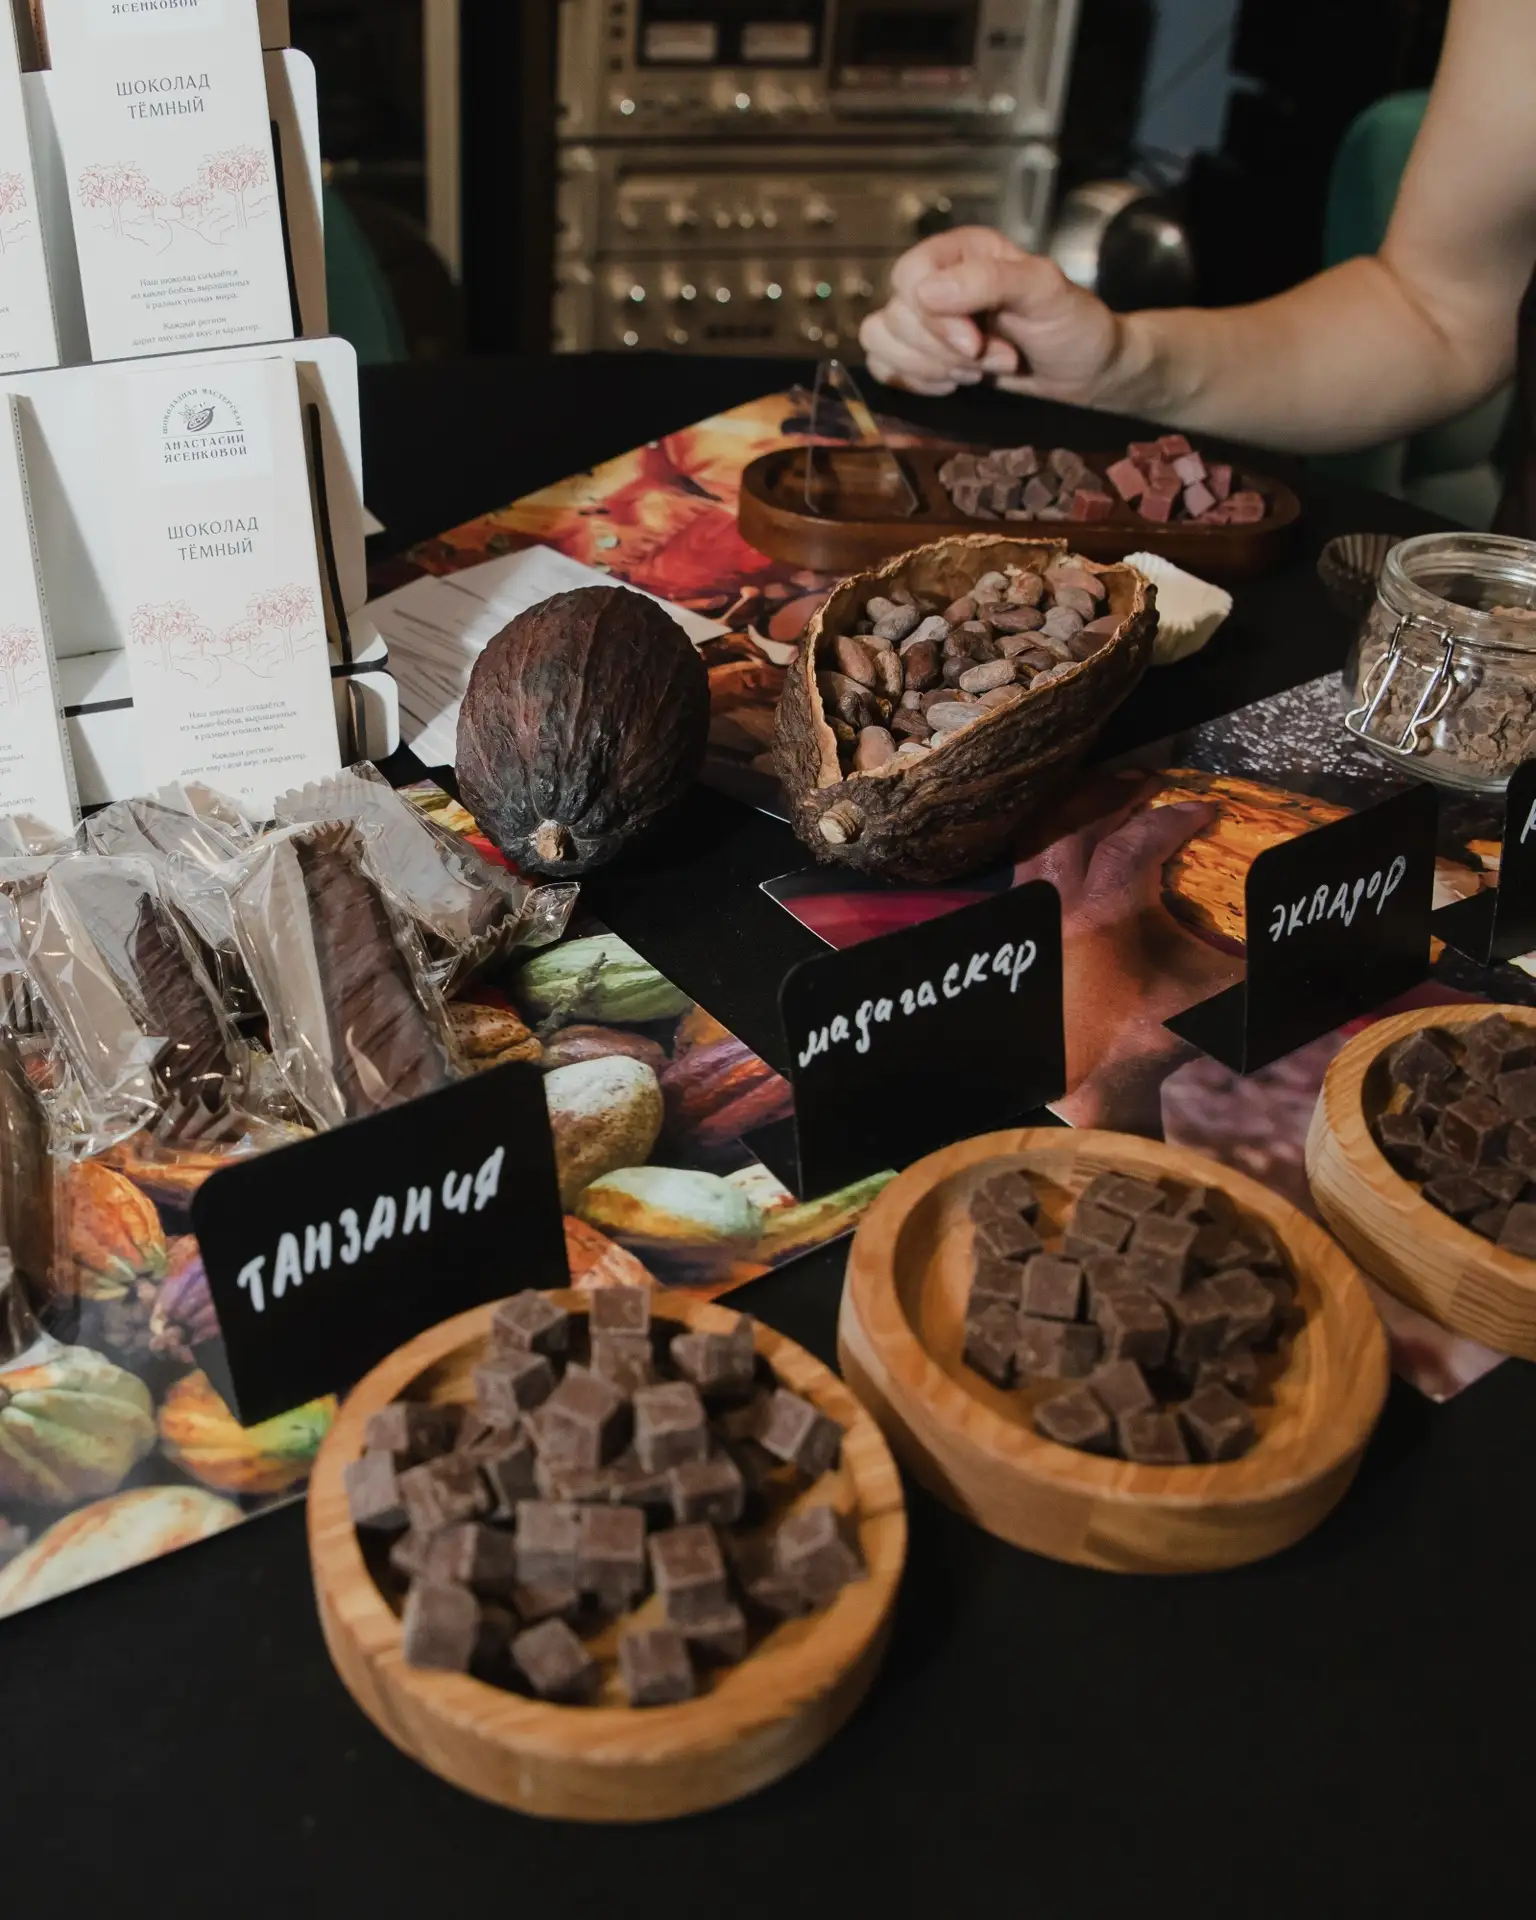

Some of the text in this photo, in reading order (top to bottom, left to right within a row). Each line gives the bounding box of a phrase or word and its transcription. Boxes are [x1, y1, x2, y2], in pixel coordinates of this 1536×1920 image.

[116, 73, 211, 96] ШОКОЛАД
[127, 96, 204, 119] ТЁМНЫЙ
[140, 279, 159, 287] Наш
[163, 316, 227, 330] Каждый регион
[164, 434, 244, 451] АНАСТАСИИ
[168, 516, 259, 540] ШОКОЛАД
[178, 537, 253, 561] ТЁМНЫЙ
[189, 711, 207, 719] Наш
[211, 750, 244, 760] Каждый
[236, 1145, 505, 1313] ТАНЗАНИЯ
